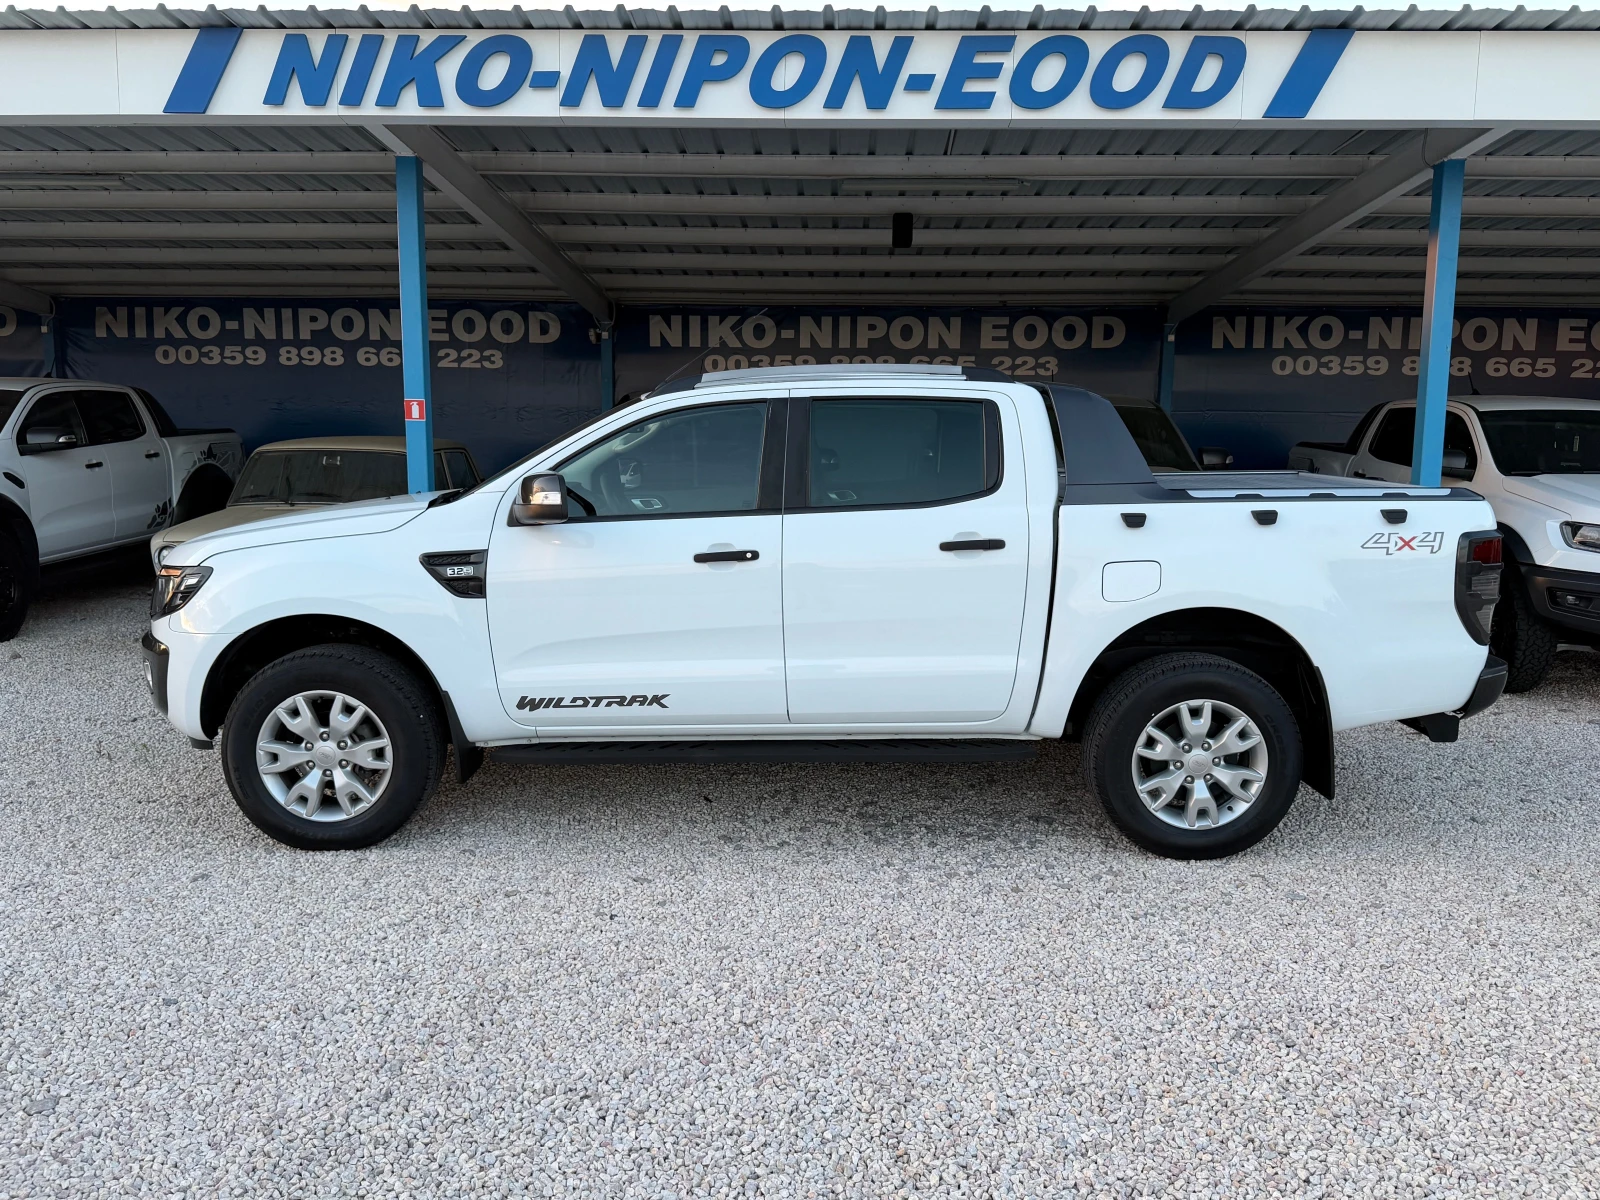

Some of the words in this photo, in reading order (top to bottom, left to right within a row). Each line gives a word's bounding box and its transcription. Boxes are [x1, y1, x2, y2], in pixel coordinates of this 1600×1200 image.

[262, 33, 1248, 110] NIKO-NIPON-EOOD
[95, 306, 402, 341] NIKO-NIPON
[427, 308, 562, 344] EOOD
[648, 314, 962, 350] NIKO-NIPON
[980, 315, 1127, 350] EOOD
[1211, 315, 1539, 352] NIKO-NION
[155, 345, 267, 366] 00359
[278, 346, 345, 367] 898
[356, 347, 402, 368] 66
[437, 348, 504, 369] 223
[991, 356, 1059, 376] 223
[1271, 355, 1389, 376] 00359
[1401, 356, 1472, 378] 88
[1485, 357, 1557, 378] 665
[515, 693, 672, 712] WILDTRAK
